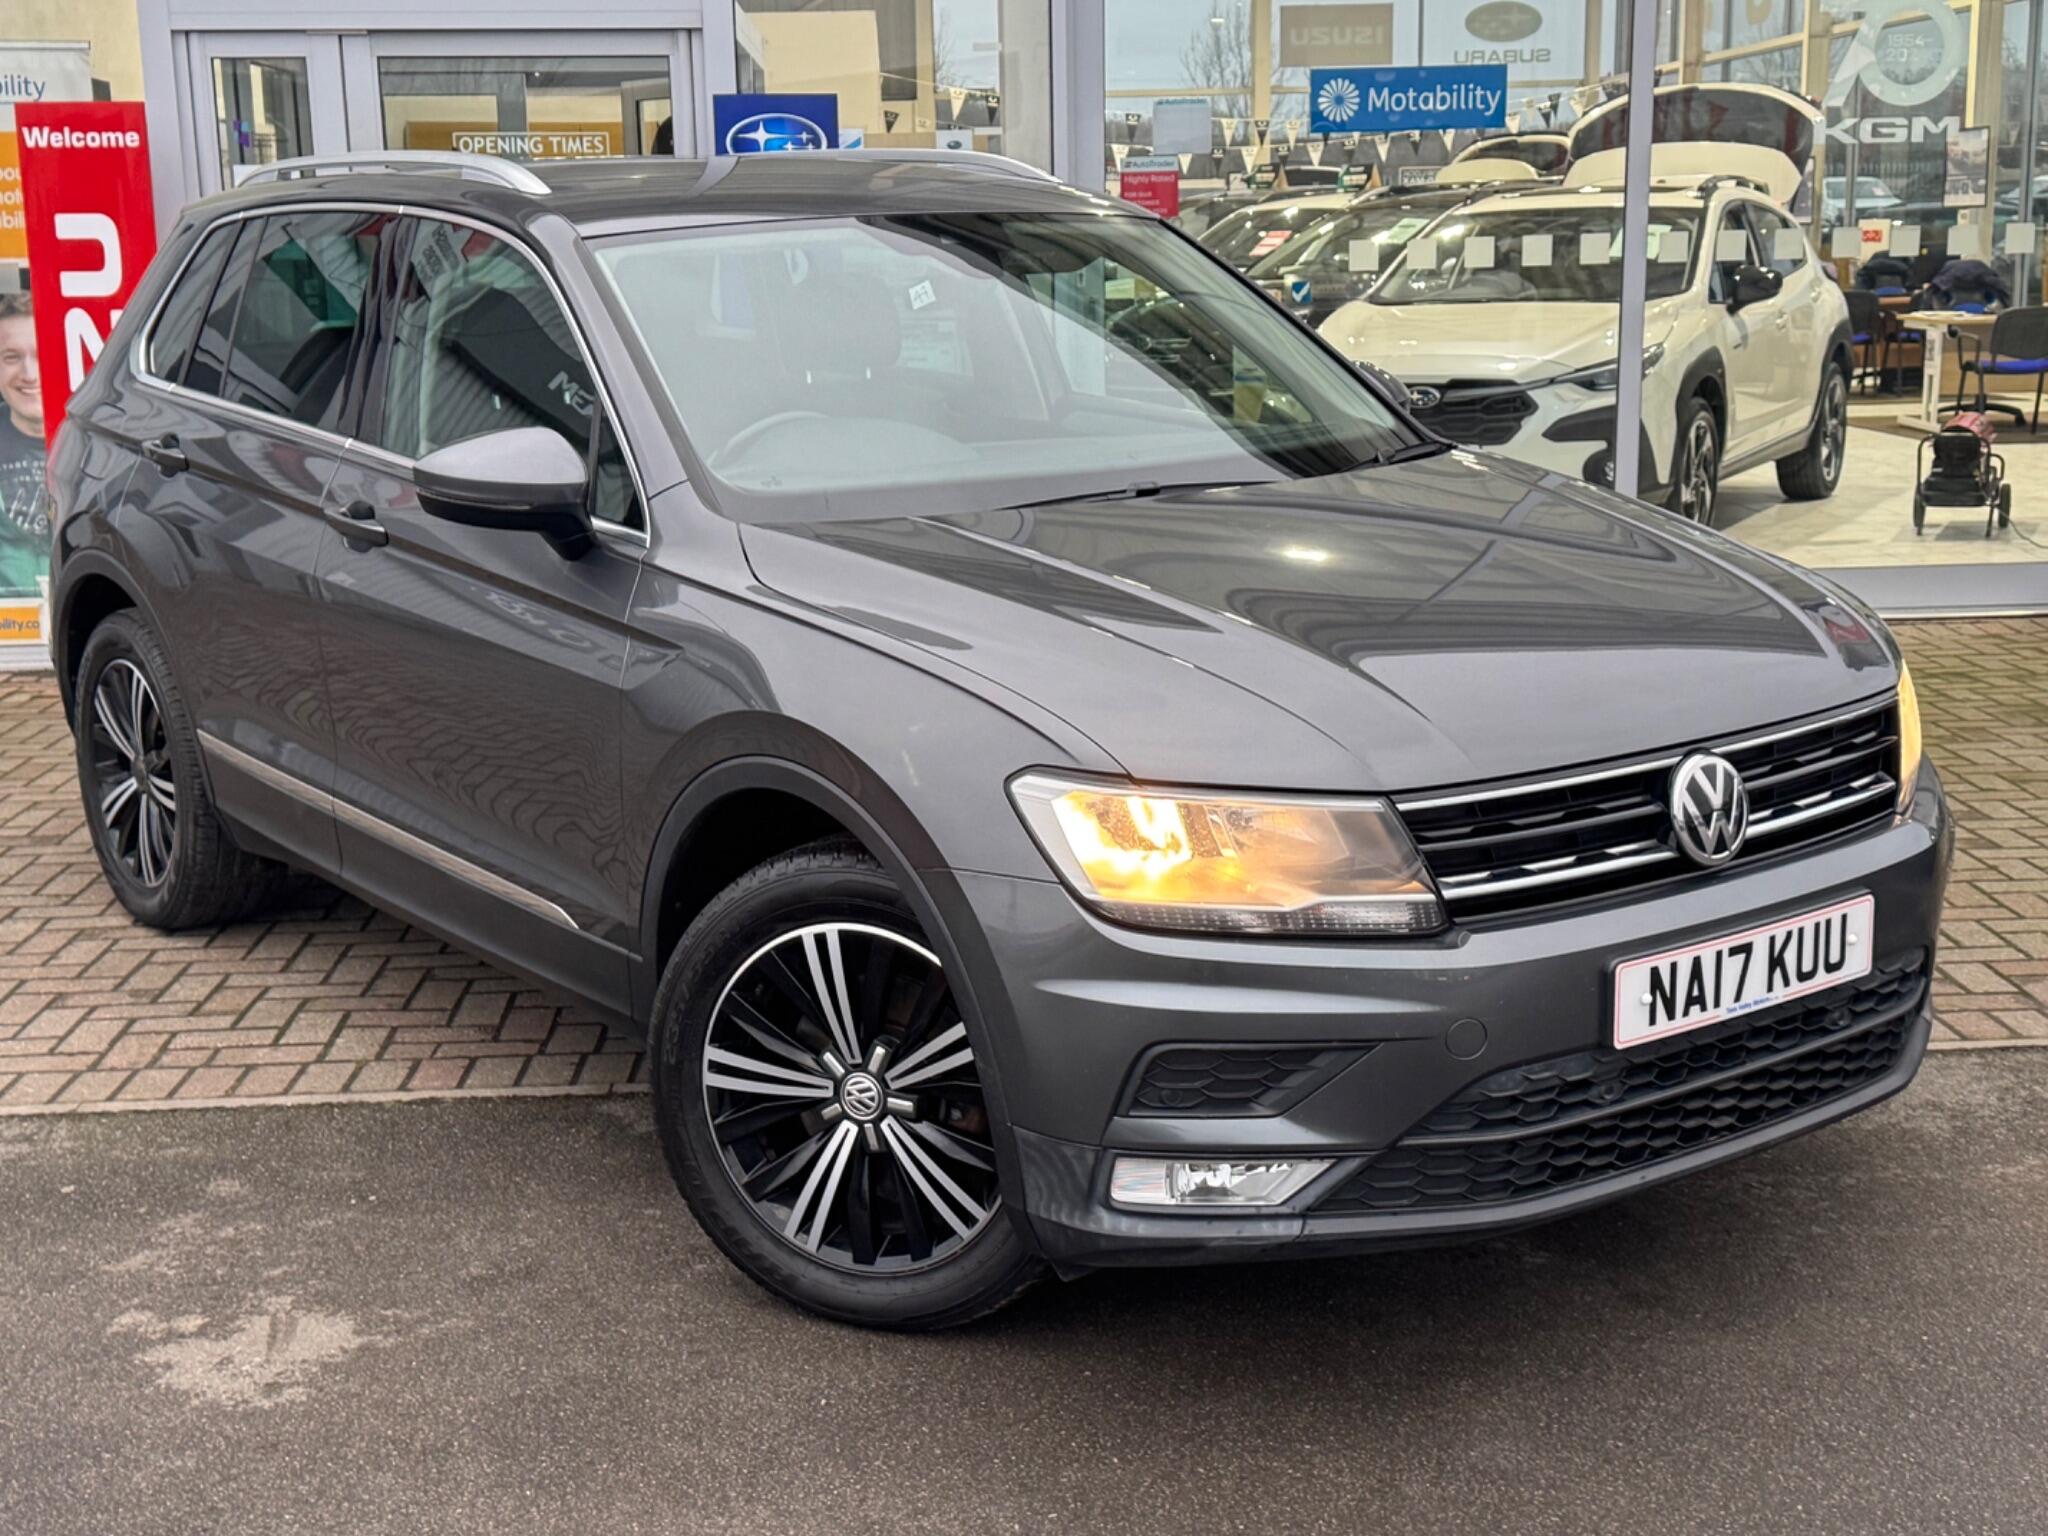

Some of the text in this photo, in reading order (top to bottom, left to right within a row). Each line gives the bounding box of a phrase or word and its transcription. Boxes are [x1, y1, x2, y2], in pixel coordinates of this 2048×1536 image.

[0, 74, 46, 102] ility
[1367, 82, 1503, 116] Motability
[21, 126, 140, 149] Welcome
[459, 136, 605, 154] OPENING TIMES
[1648, 913, 1848, 1027] NA17 KUU
